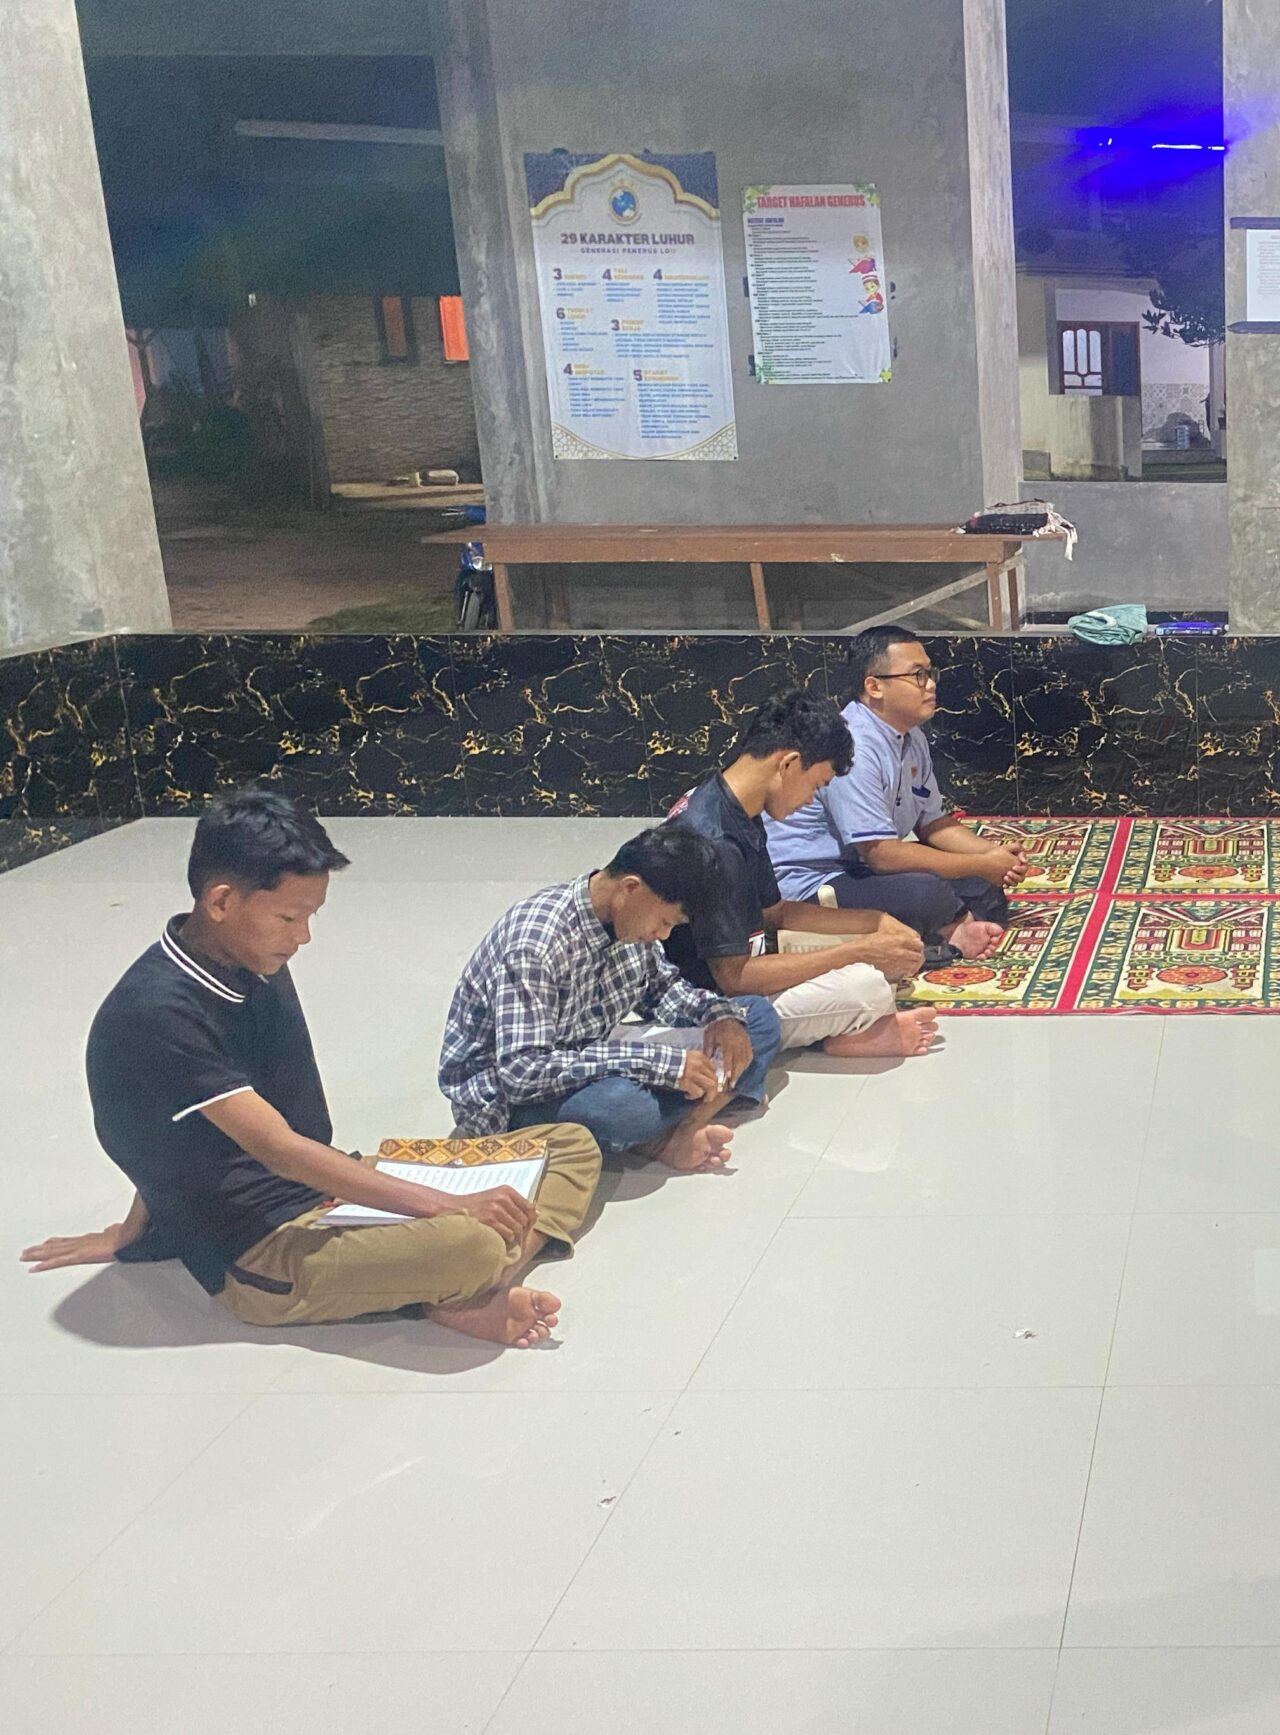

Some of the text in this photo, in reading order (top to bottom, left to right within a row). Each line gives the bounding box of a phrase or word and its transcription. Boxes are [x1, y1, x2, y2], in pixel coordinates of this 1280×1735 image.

[757, 196, 787, 208] TARGET
[560, 232, 695, 245] 29 KARAKTER LUHUR
[552, 267, 563, 280] 3
[602, 268, 612, 281] 4
[653, 268, 663, 281] 4
[556, 307, 566, 320] 6
[611, 319, 621, 331] 3
[563, 363, 573, 375] 4
[633, 369, 643, 382] 5
